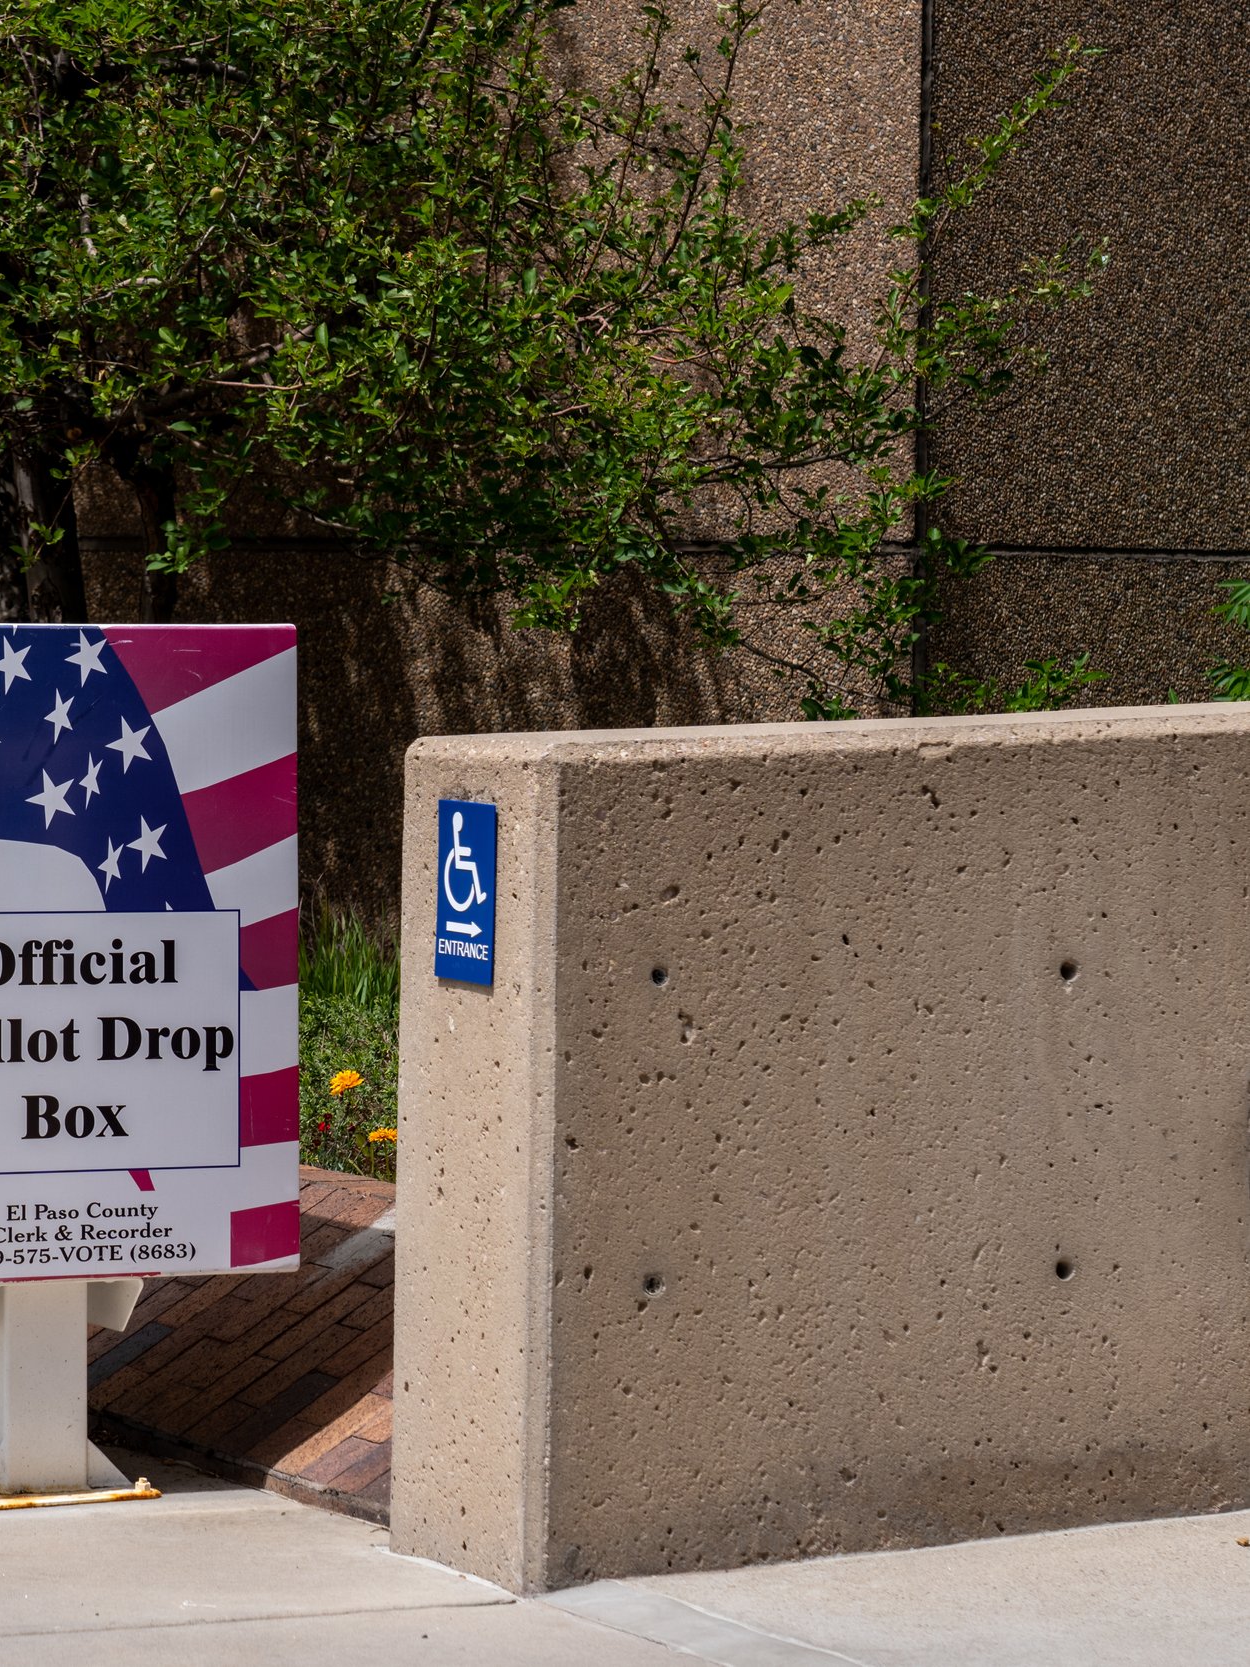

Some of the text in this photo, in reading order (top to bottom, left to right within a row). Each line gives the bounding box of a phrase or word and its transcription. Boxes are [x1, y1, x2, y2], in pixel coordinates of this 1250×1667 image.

[438, 938, 489, 961] ENTRANCE
[96, 1016, 235, 1072] Drop
[20, 1094, 130, 1140] Box
[6, 1201, 159, 1222] El Paso County
[54, 1224, 74, 1242] &
[80, 1222, 173, 1241] Recorder
[129, 1241, 197, 1263] (8683)
